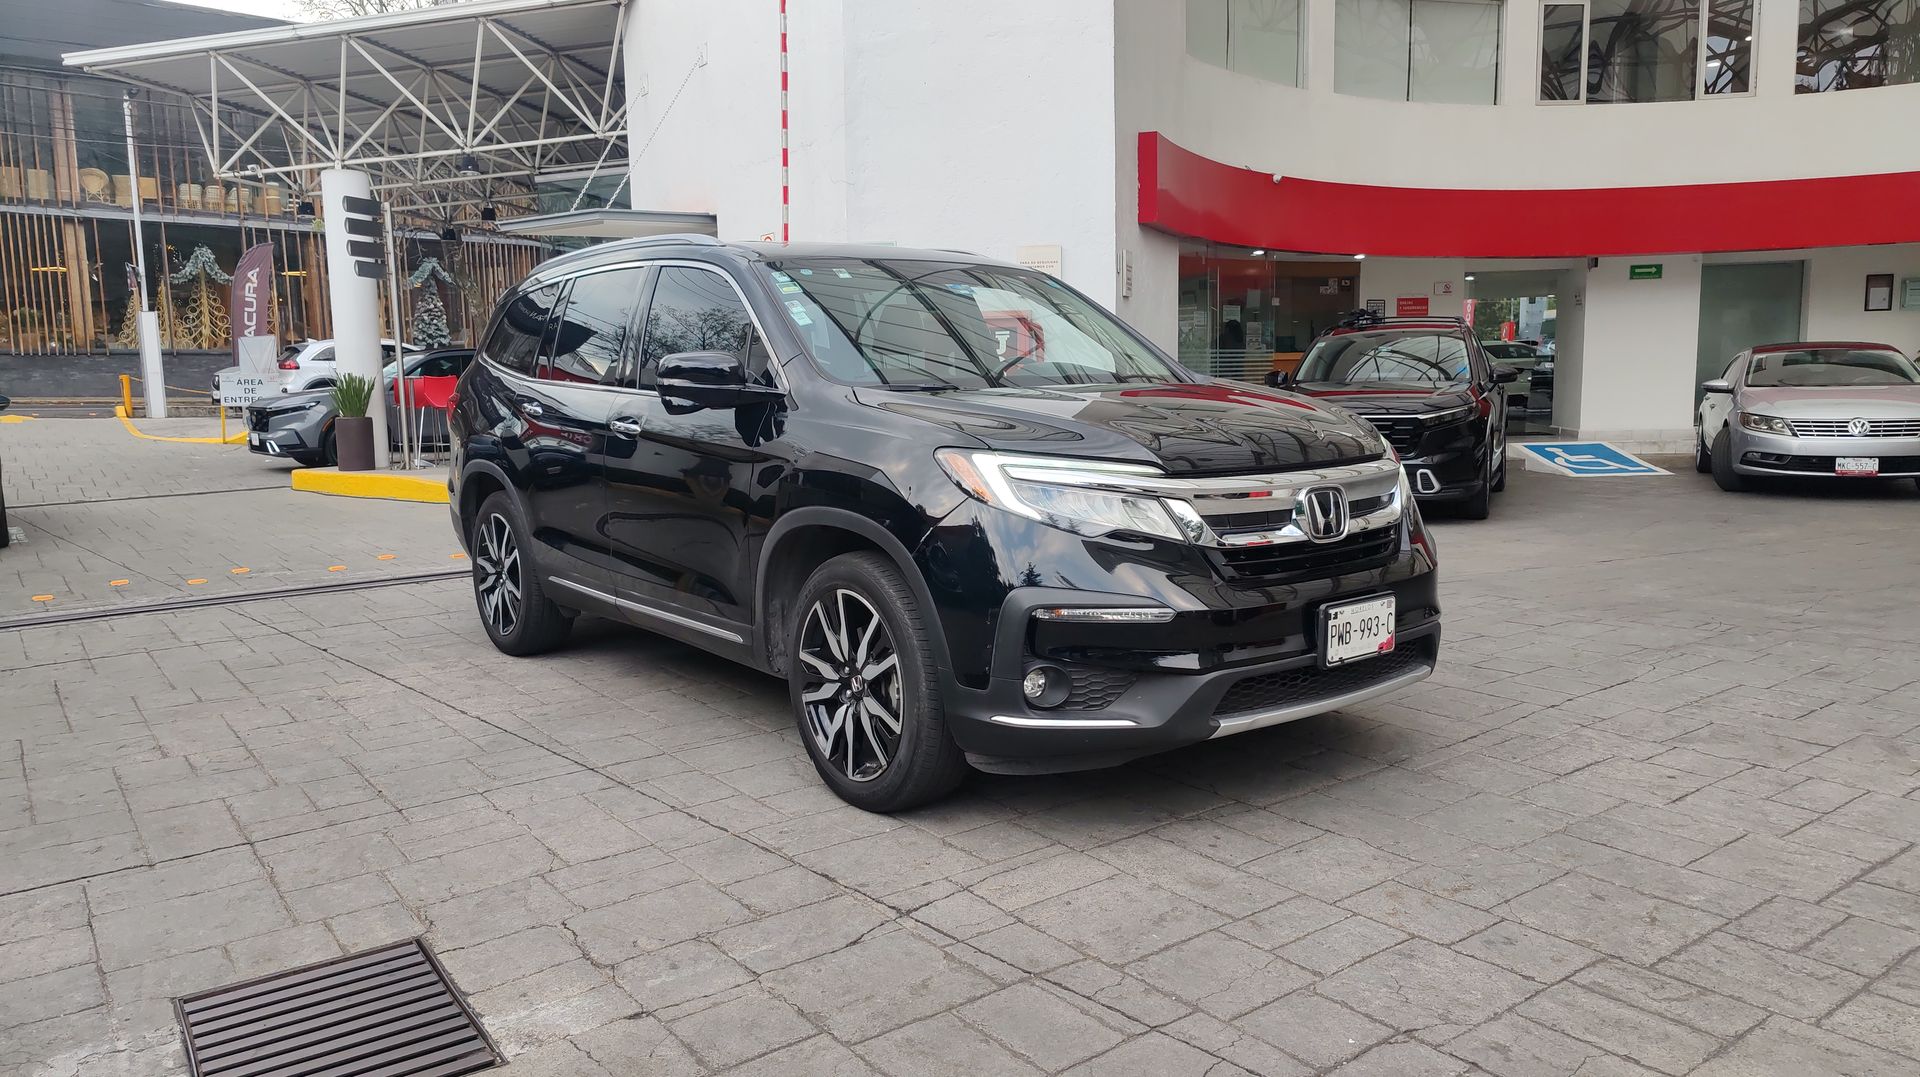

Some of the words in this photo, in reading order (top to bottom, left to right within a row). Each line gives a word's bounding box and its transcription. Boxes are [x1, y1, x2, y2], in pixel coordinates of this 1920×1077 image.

[243, 267, 260, 337] ACURA
[236, 376, 264, 386] ÁREA
[243, 387, 258, 395] DE
[1330, 612, 1393, 649] PWB-993-C
